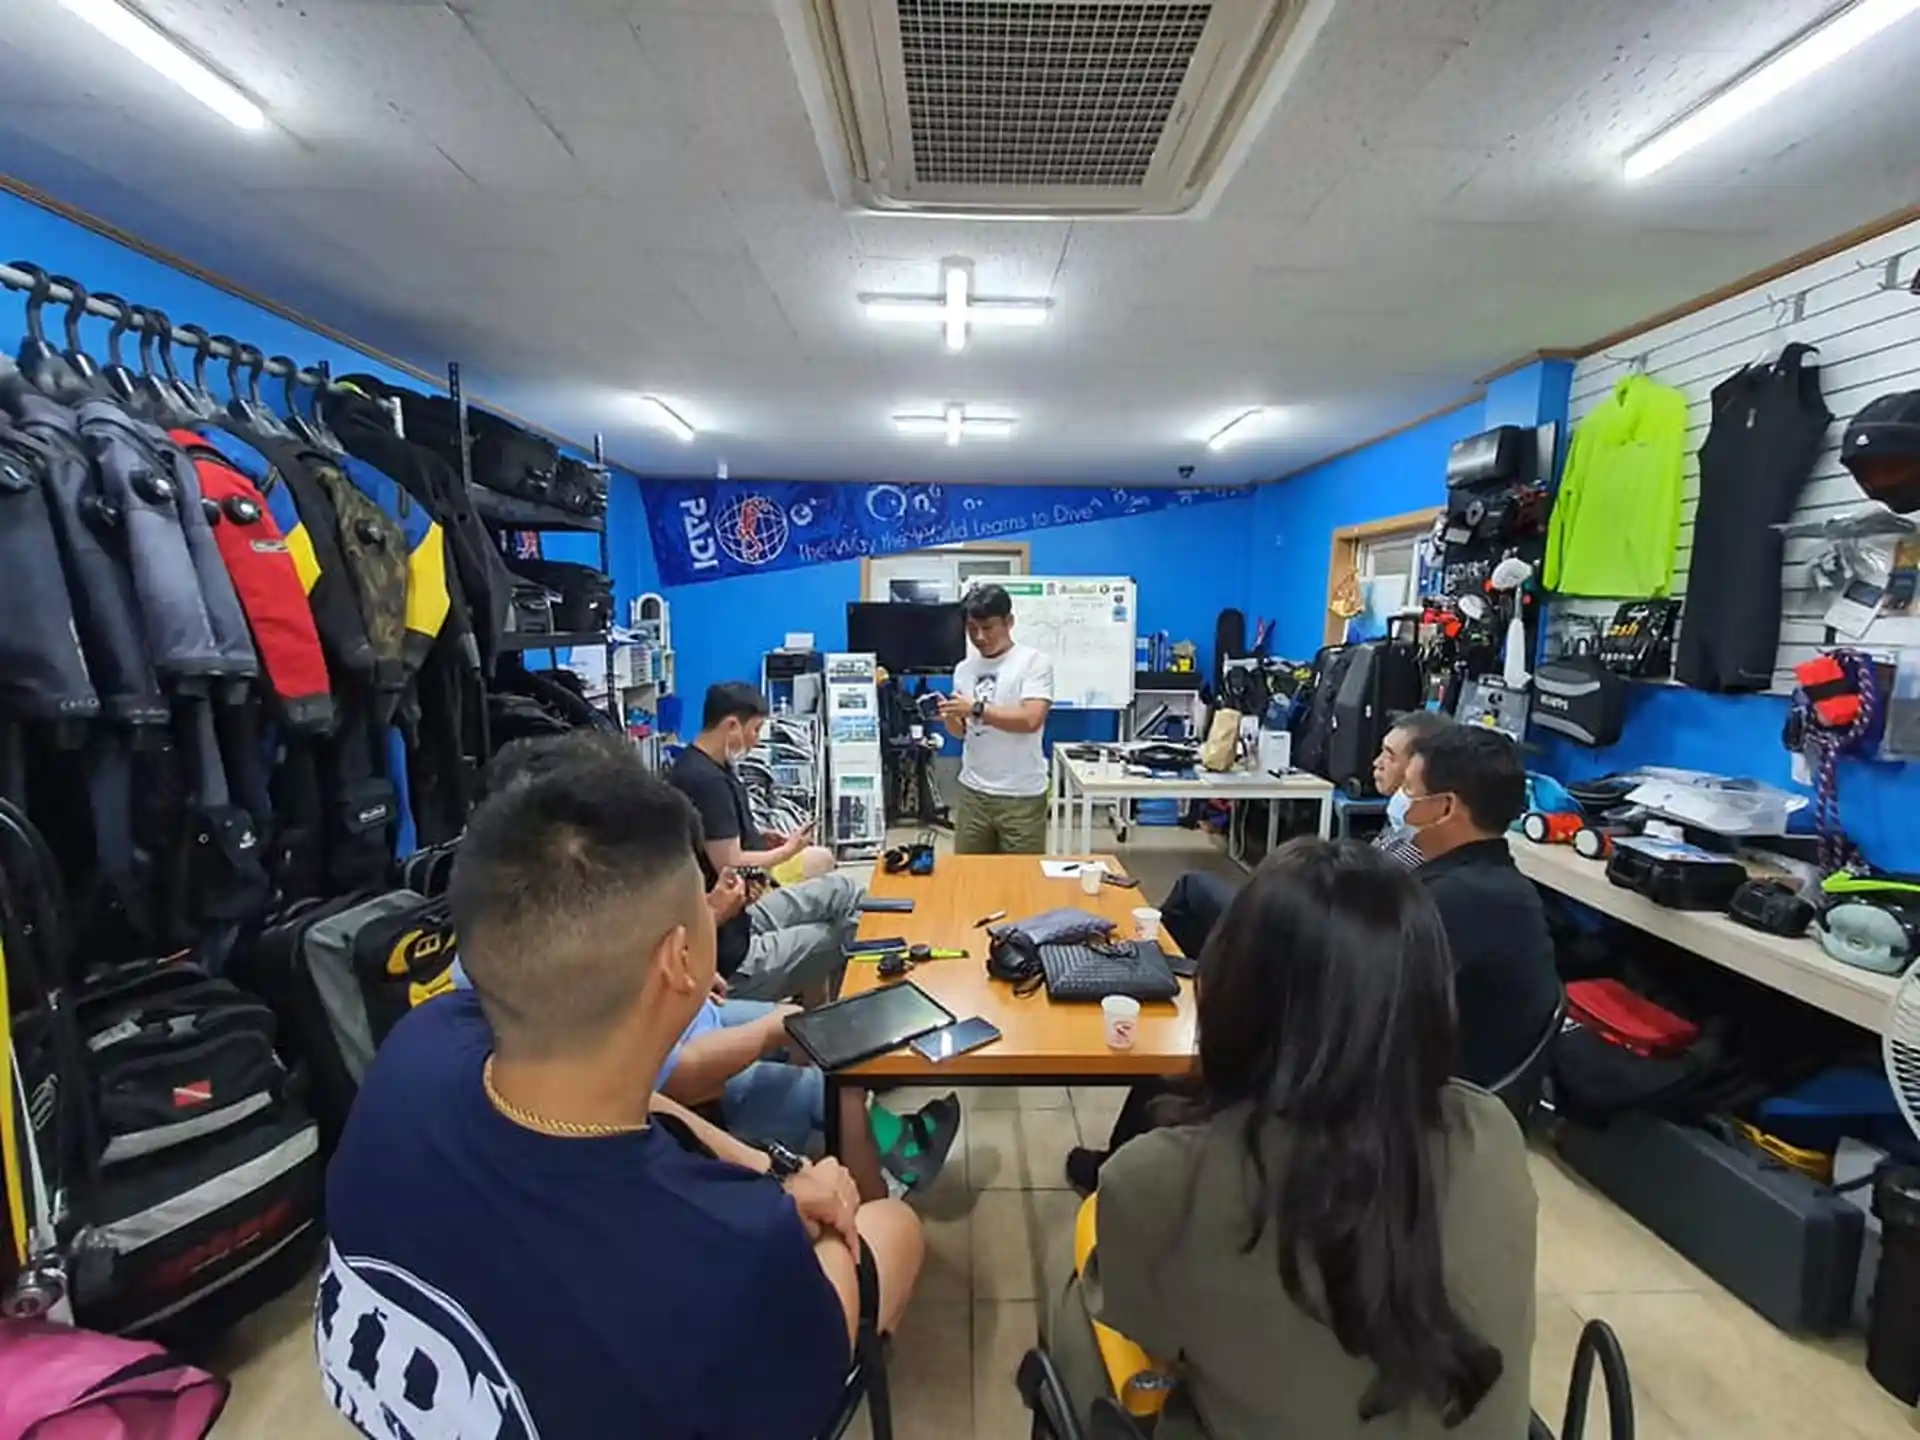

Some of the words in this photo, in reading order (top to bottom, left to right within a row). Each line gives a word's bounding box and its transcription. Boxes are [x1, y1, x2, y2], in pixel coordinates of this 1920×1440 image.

[680, 497, 720, 569] PADI
[973, 517, 1028, 537] Learns
[1032, 511, 1048, 527] to
